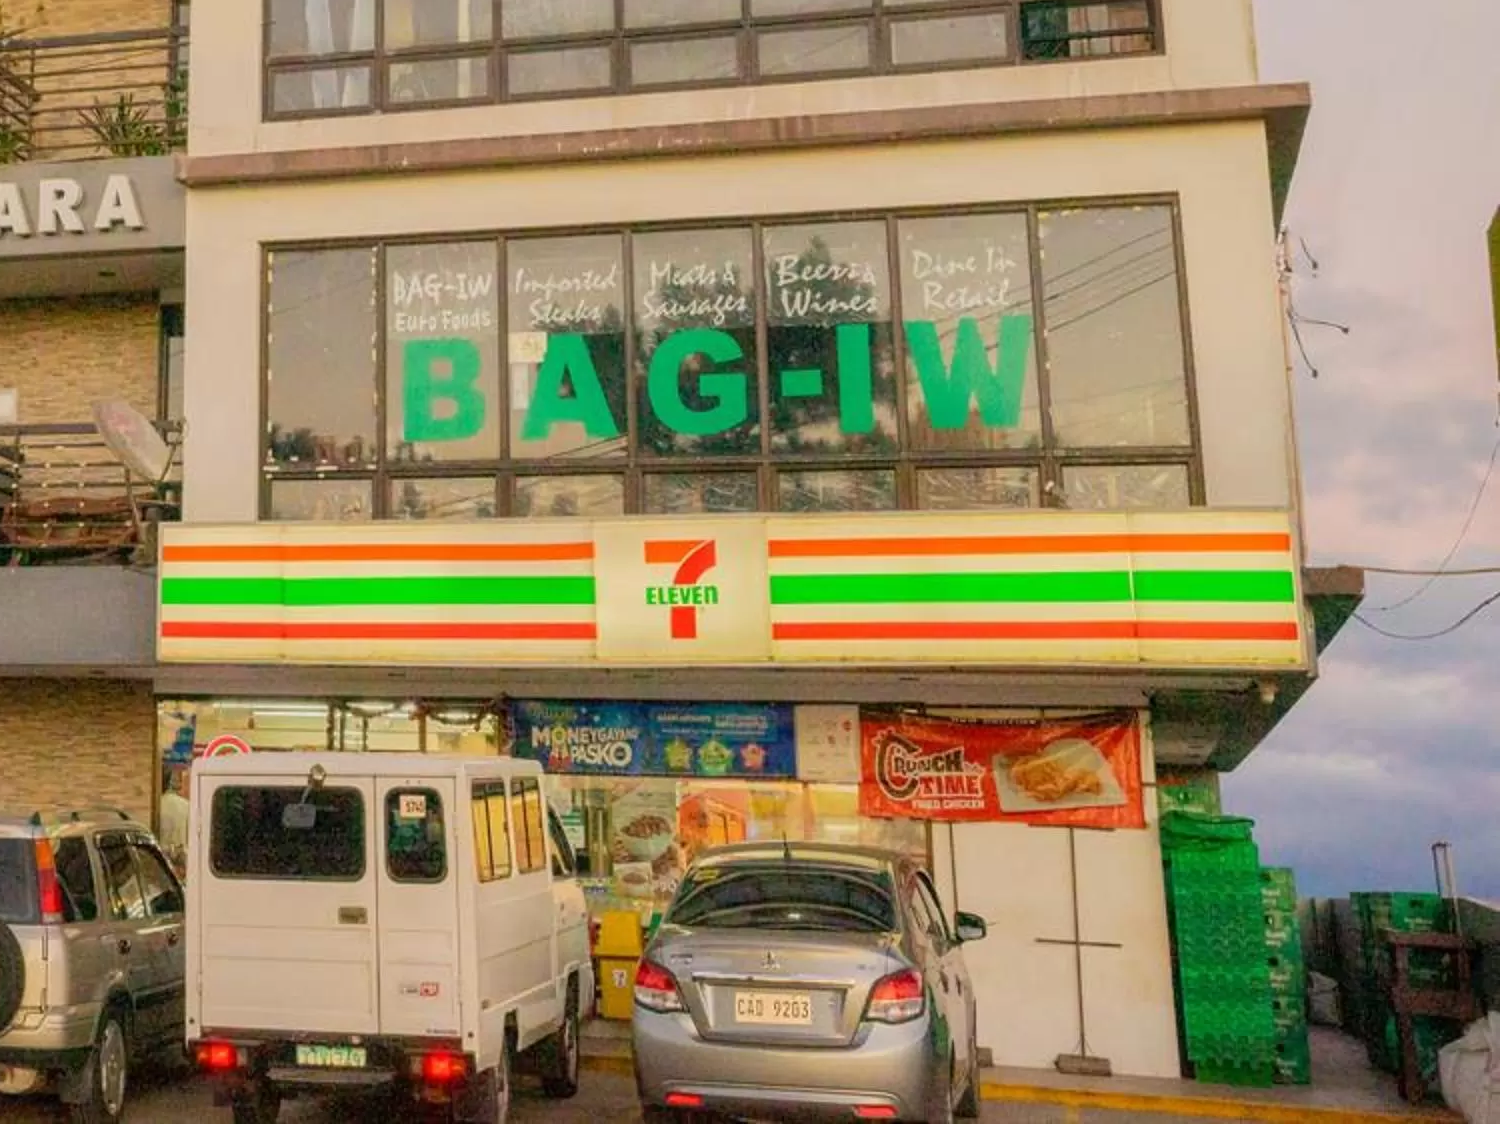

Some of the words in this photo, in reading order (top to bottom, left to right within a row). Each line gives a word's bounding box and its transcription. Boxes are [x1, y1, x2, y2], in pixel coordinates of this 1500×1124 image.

[911, 248, 977, 279] Dine
[986, 246, 1017, 274] In
[393, 271, 493, 305] BAG-IW
[515, 263, 618, 300] Imported
[923, 279, 1012, 311] Retail
[439, 307, 492, 330] Foods
[642, 290, 749, 326] Sausages
[781, 288, 879, 318] Wines
[643, 539, 717, 640] 7
[571, 739, 633, 767] PASKO
[920, 775, 982, 796] TIME
